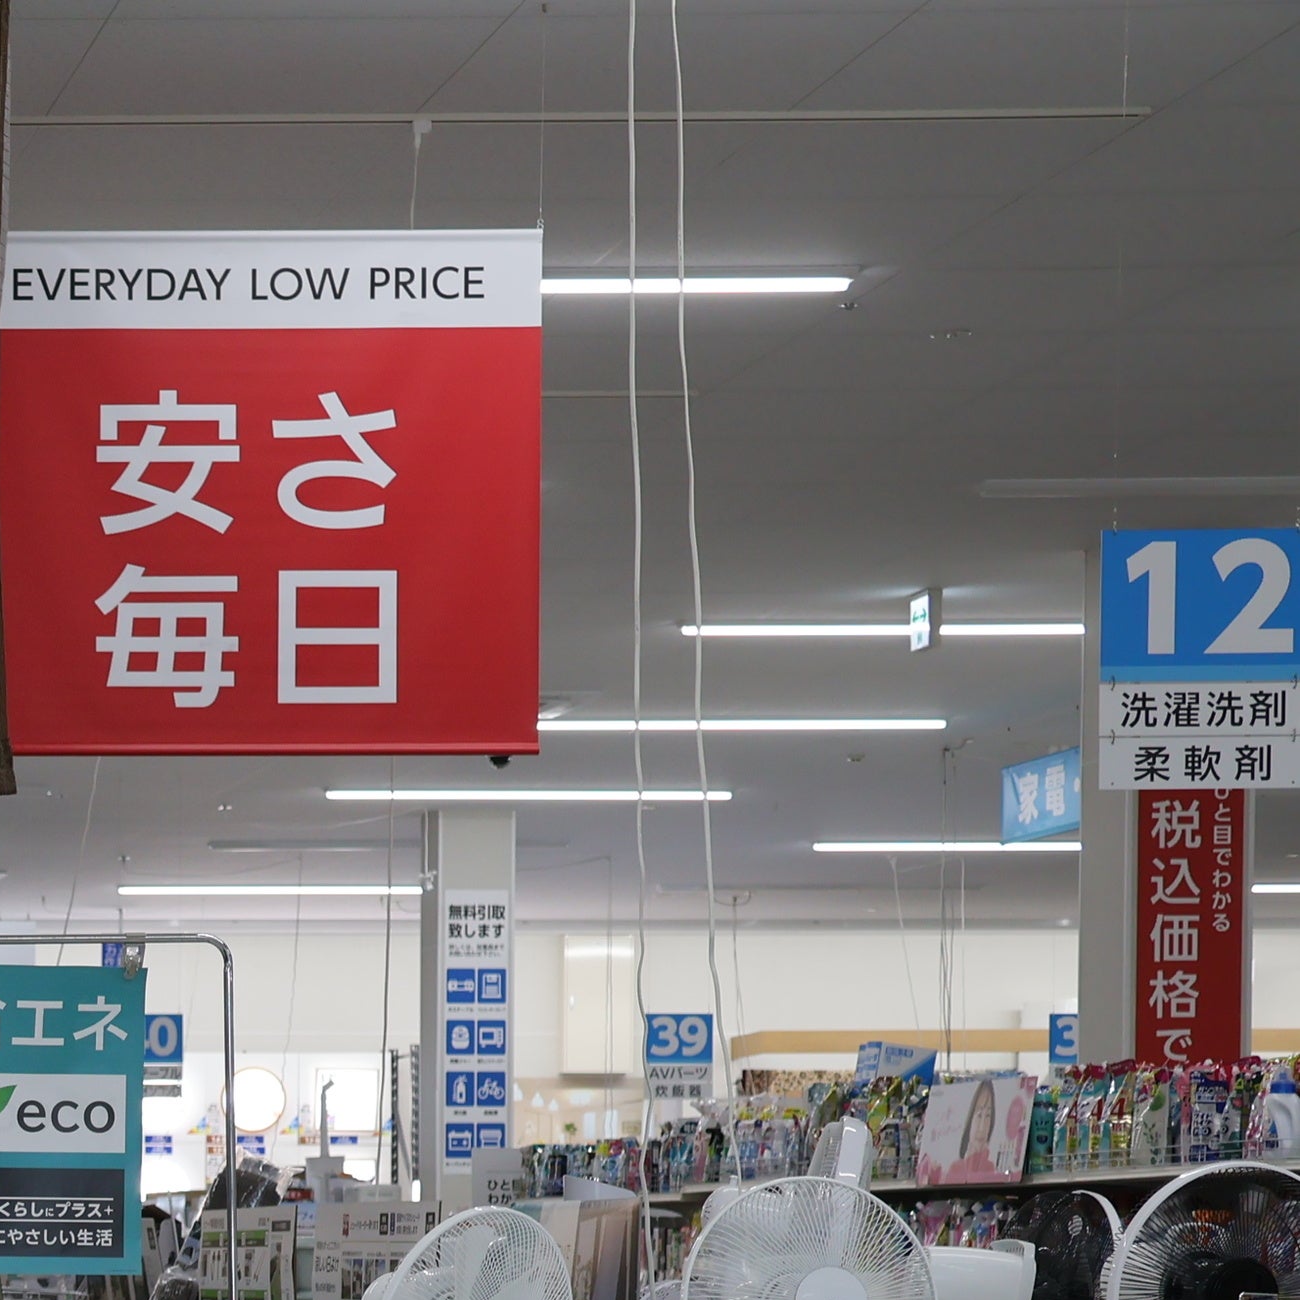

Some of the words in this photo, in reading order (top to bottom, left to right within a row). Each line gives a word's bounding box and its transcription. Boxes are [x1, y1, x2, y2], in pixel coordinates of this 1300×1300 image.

[12, 269, 231, 300] EVERYDAY
[251, 268, 349, 300] LOW
[370, 267, 484, 299] PRICE
[96, 390, 397, 535] 安さ
[1126, 537, 1294, 655] 12
[95, 563, 397, 708] 毎日
[1120, 690, 1286, 728] 洗濯洗剤
[1133, 744, 1272, 782] 柔軟剤
[447, 904, 506, 921] 無料引取
[447, 922, 505, 939] 致します
[650, 1016, 709, 1056] 39
[16, 1100, 116, 1134] eco
